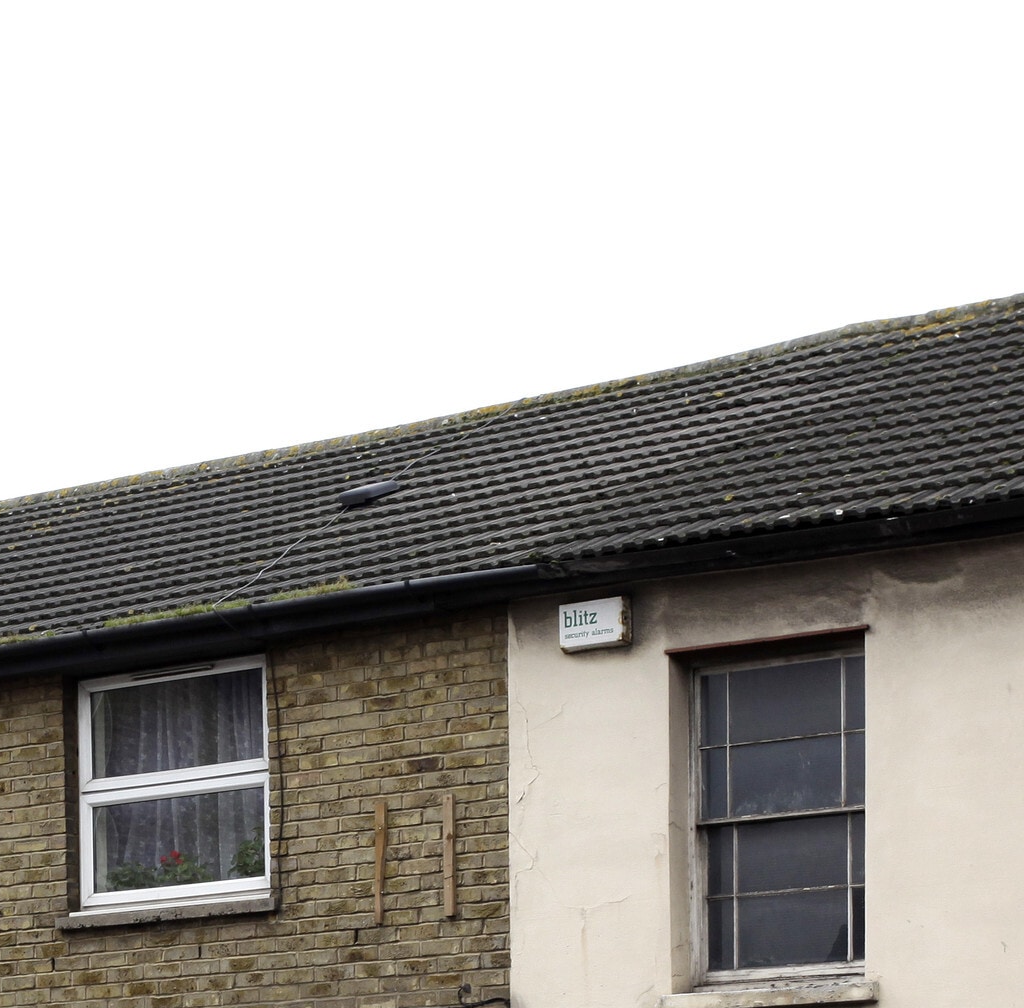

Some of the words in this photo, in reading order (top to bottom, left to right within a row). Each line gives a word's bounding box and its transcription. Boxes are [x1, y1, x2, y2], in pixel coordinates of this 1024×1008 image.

[563, 609, 598, 628] blitz
[564, 631, 590, 640] security
[591, 627, 614, 636] alarms
